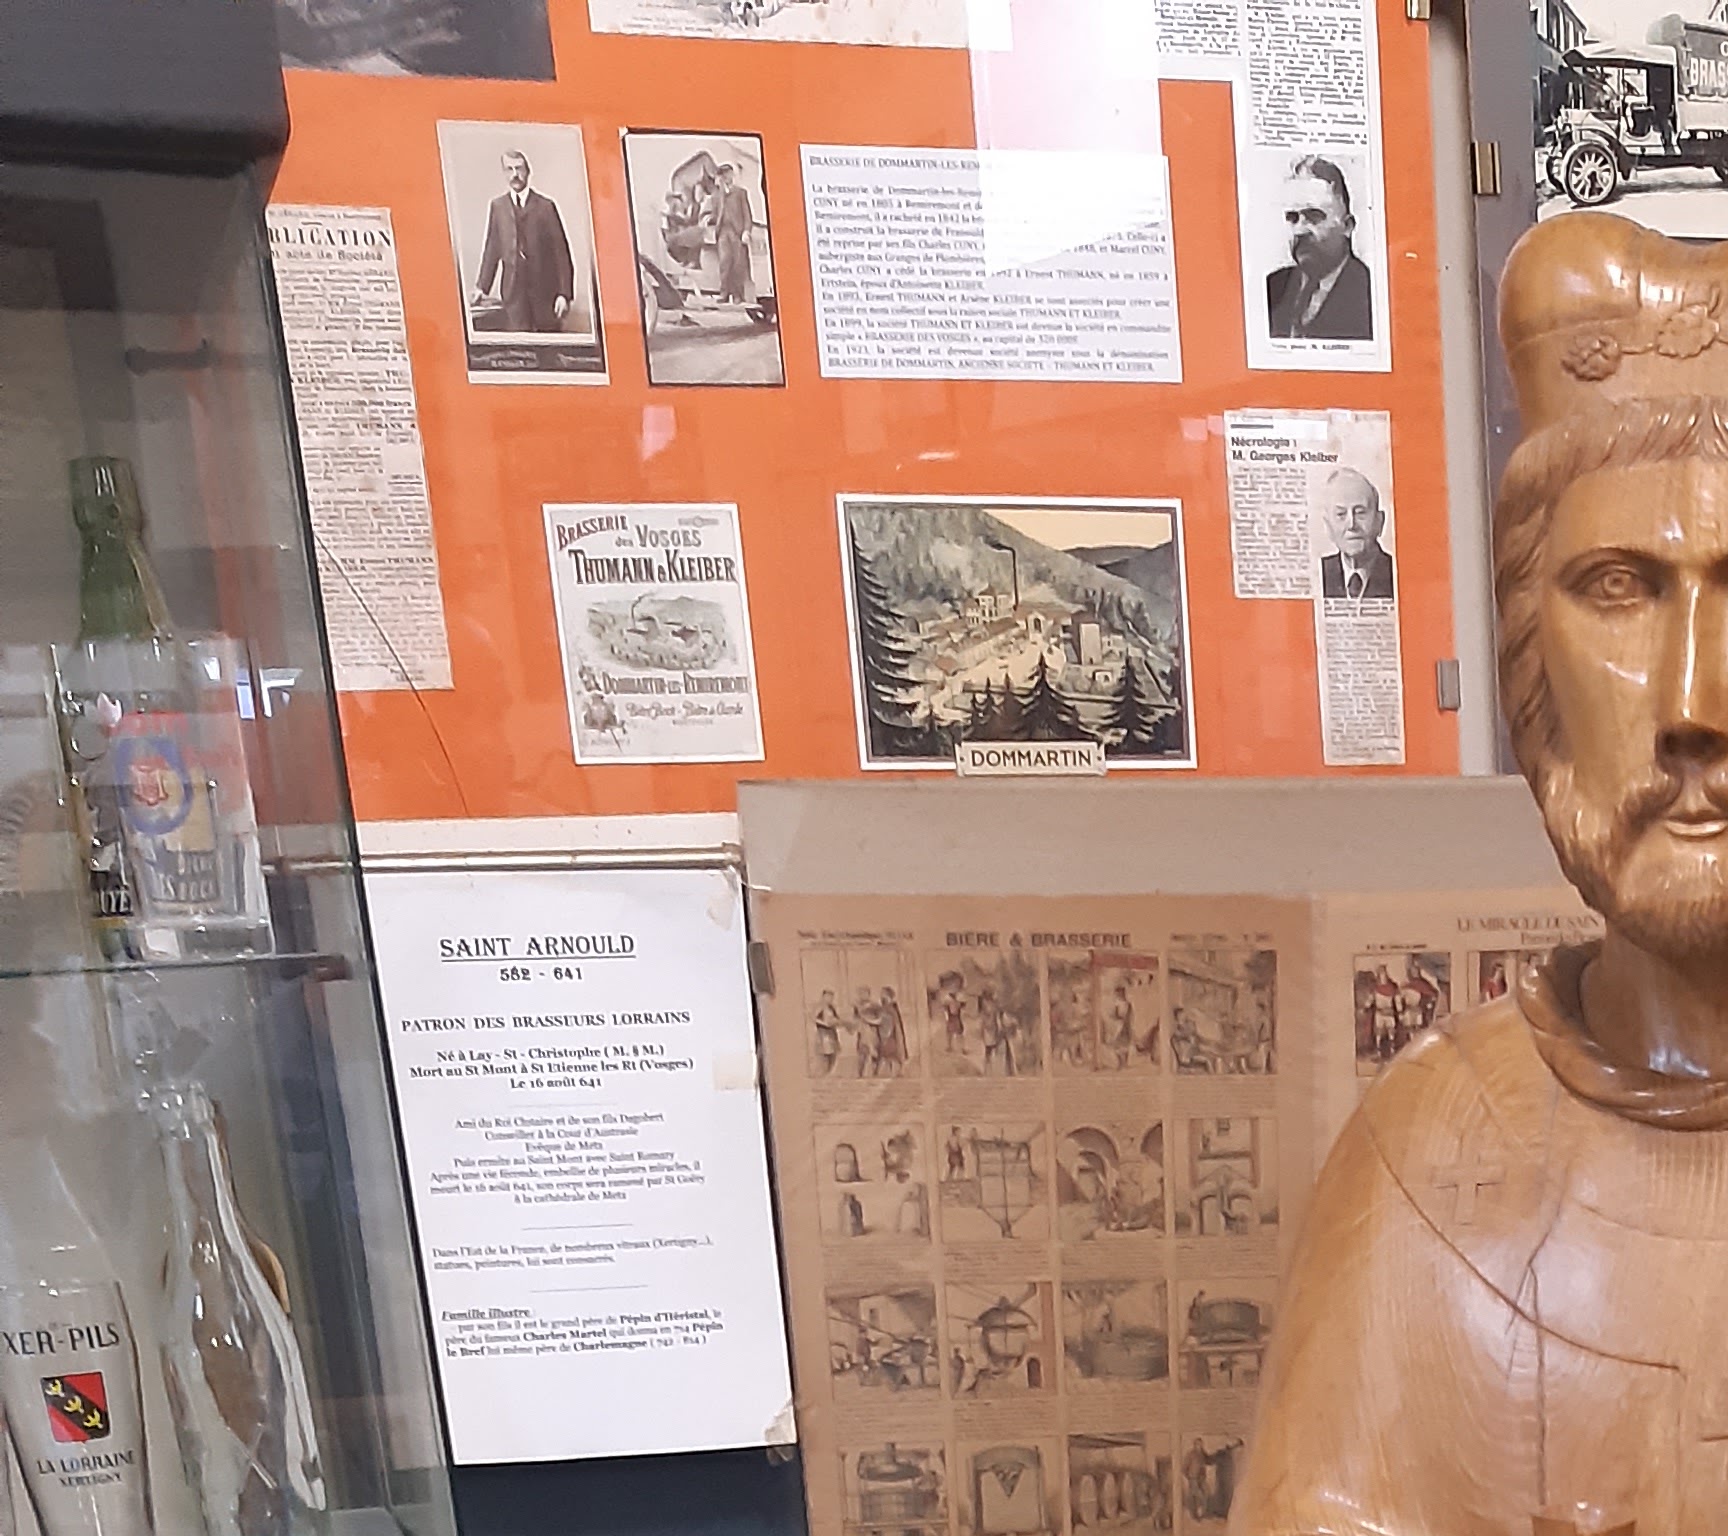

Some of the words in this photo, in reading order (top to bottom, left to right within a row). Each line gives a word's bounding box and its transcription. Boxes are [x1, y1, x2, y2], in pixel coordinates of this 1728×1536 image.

[267, 226, 392, 247] BLICATION
[1230, 436, 1290, 449] Nécrologie
[1231, 451, 1247, 462] M.
[1249, 450, 1297, 464] Georges
[1299, 451, 1339, 464] Kleiber
[555, 515, 629, 552] BRASSERIE
[635, 524, 702, 548] VOSGES
[568, 548, 656, 585] THUMANN
[664, 548, 739, 583] KLEIBER
[971, 750, 1092, 767] DOMMARTIN
[1564, 914, 1601, 931] SAIN
[440, 936, 511, 957] SAINT
[526, 934, 635, 957] ARNOULD
[1009, 930, 1023, 949] &
[1030, 930, 1132, 949] BRASSERIE
[553, 966, 584, 981] 641
[401, 1017, 467, 1033] PATRON
[474, 1016, 506, 1030] DES
[513, 1013, 606, 1029] BRASSEURS
[612, 1011, 691, 1027] LORRAINS
[437, 1049, 455, 1063] Né
[458, 1049, 468, 1062] à
[469, 1050, 493, 1064] Lay
[503, 1048, 518, 1061] St
[528, 1045, 601, 1063] Christophe
[613, 1045, 631, 1058] M.
[409, 1065, 444, 1079] Mort
[445, 1066, 464, 1077] au
[464, 1064, 480, 1077] St
[482, 1063, 517, 1077] Mont
[520, 1061, 529, 1075] à
[530, 1061, 545, 1074] St
[547, 1060, 599, 1074] Etienne
[600, 1059, 619, 1073] les
[639, 1057, 694, 1073] (Vosges)
[510, 1077, 526, 1089] Le
[529, 1077, 545, 1089] 16
[546, 1075, 577, 1088] août
[578, 1076, 602, 1089] 641
[441, 1309, 486, 1321] Famille
[488, 1307, 531, 1319] illustre
[619, 1313, 652, 1326] Pépin
[0, 1322, 121, 1356] XER-PILS
[522, 1331, 568, 1342] Charles
[569, 1328, 607, 1338] Martel
[692, 1321, 725, 1333] Pépin
[446, 1346, 458, 1358] le
[459, 1345, 486, 1357] Bref
[573, 1338, 648, 1352] Charlemagne
[36, 1458, 57, 1475] LA
[60, 1449, 137, 1474] LORRAINE
